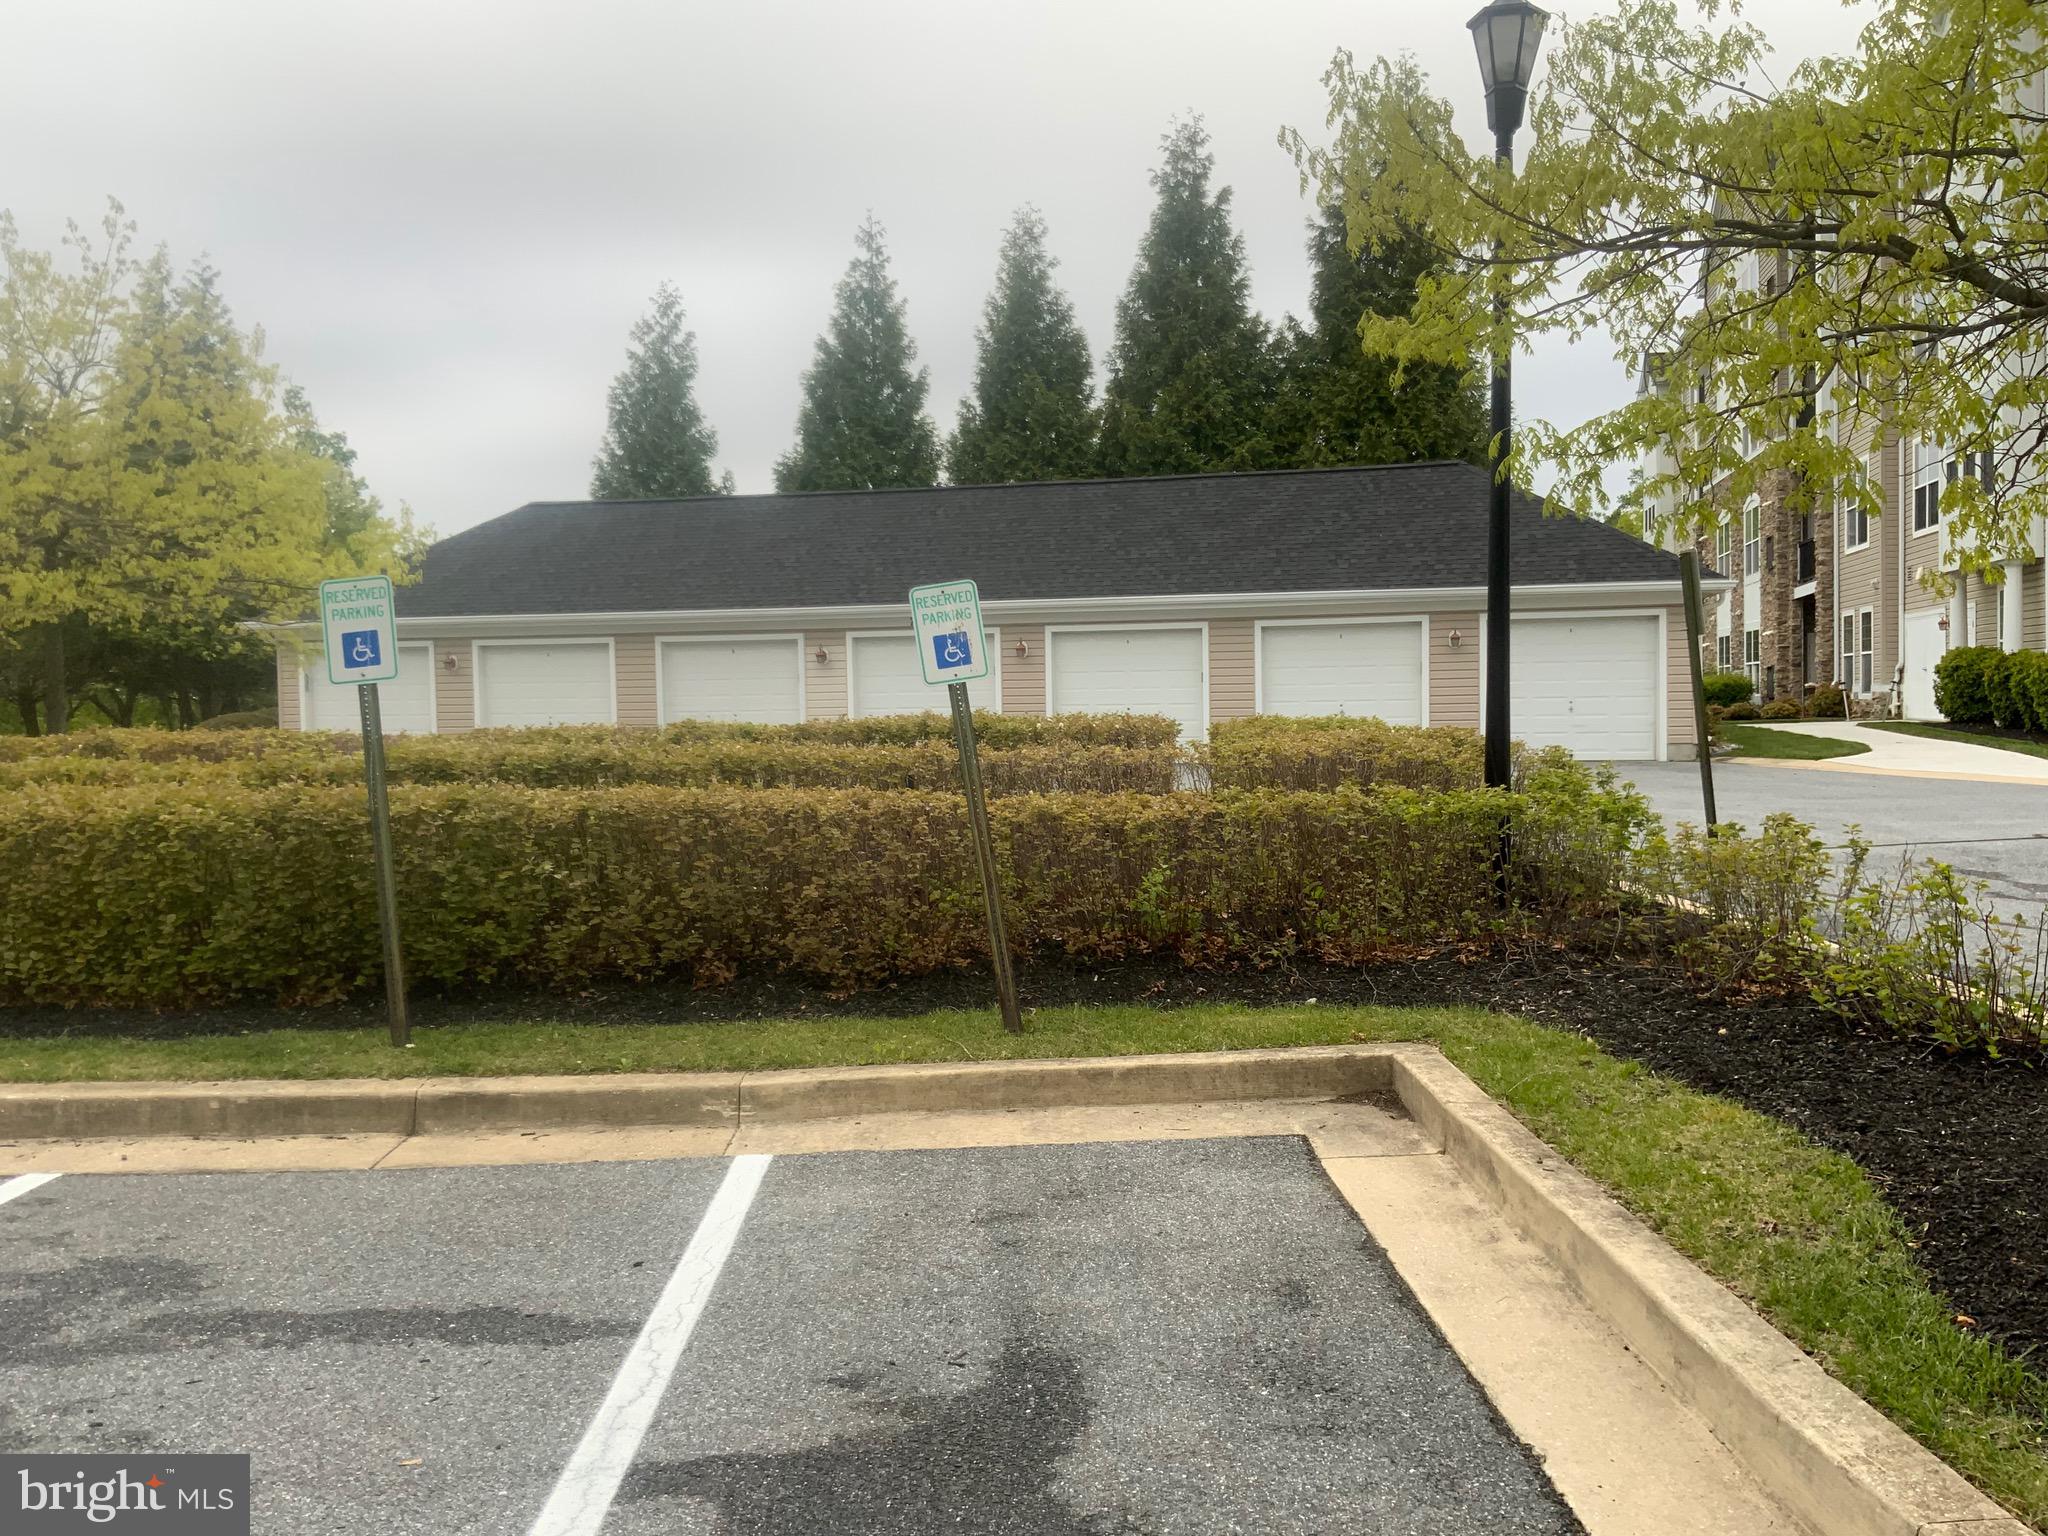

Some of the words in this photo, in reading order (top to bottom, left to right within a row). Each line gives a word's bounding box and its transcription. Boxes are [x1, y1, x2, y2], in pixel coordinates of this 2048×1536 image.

[325, 586, 387, 605] RESERVED
[915, 590, 973, 610] RESERVED
[331, 604, 385, 621] PARKING
[922, 607, 972, 626] PARKING
